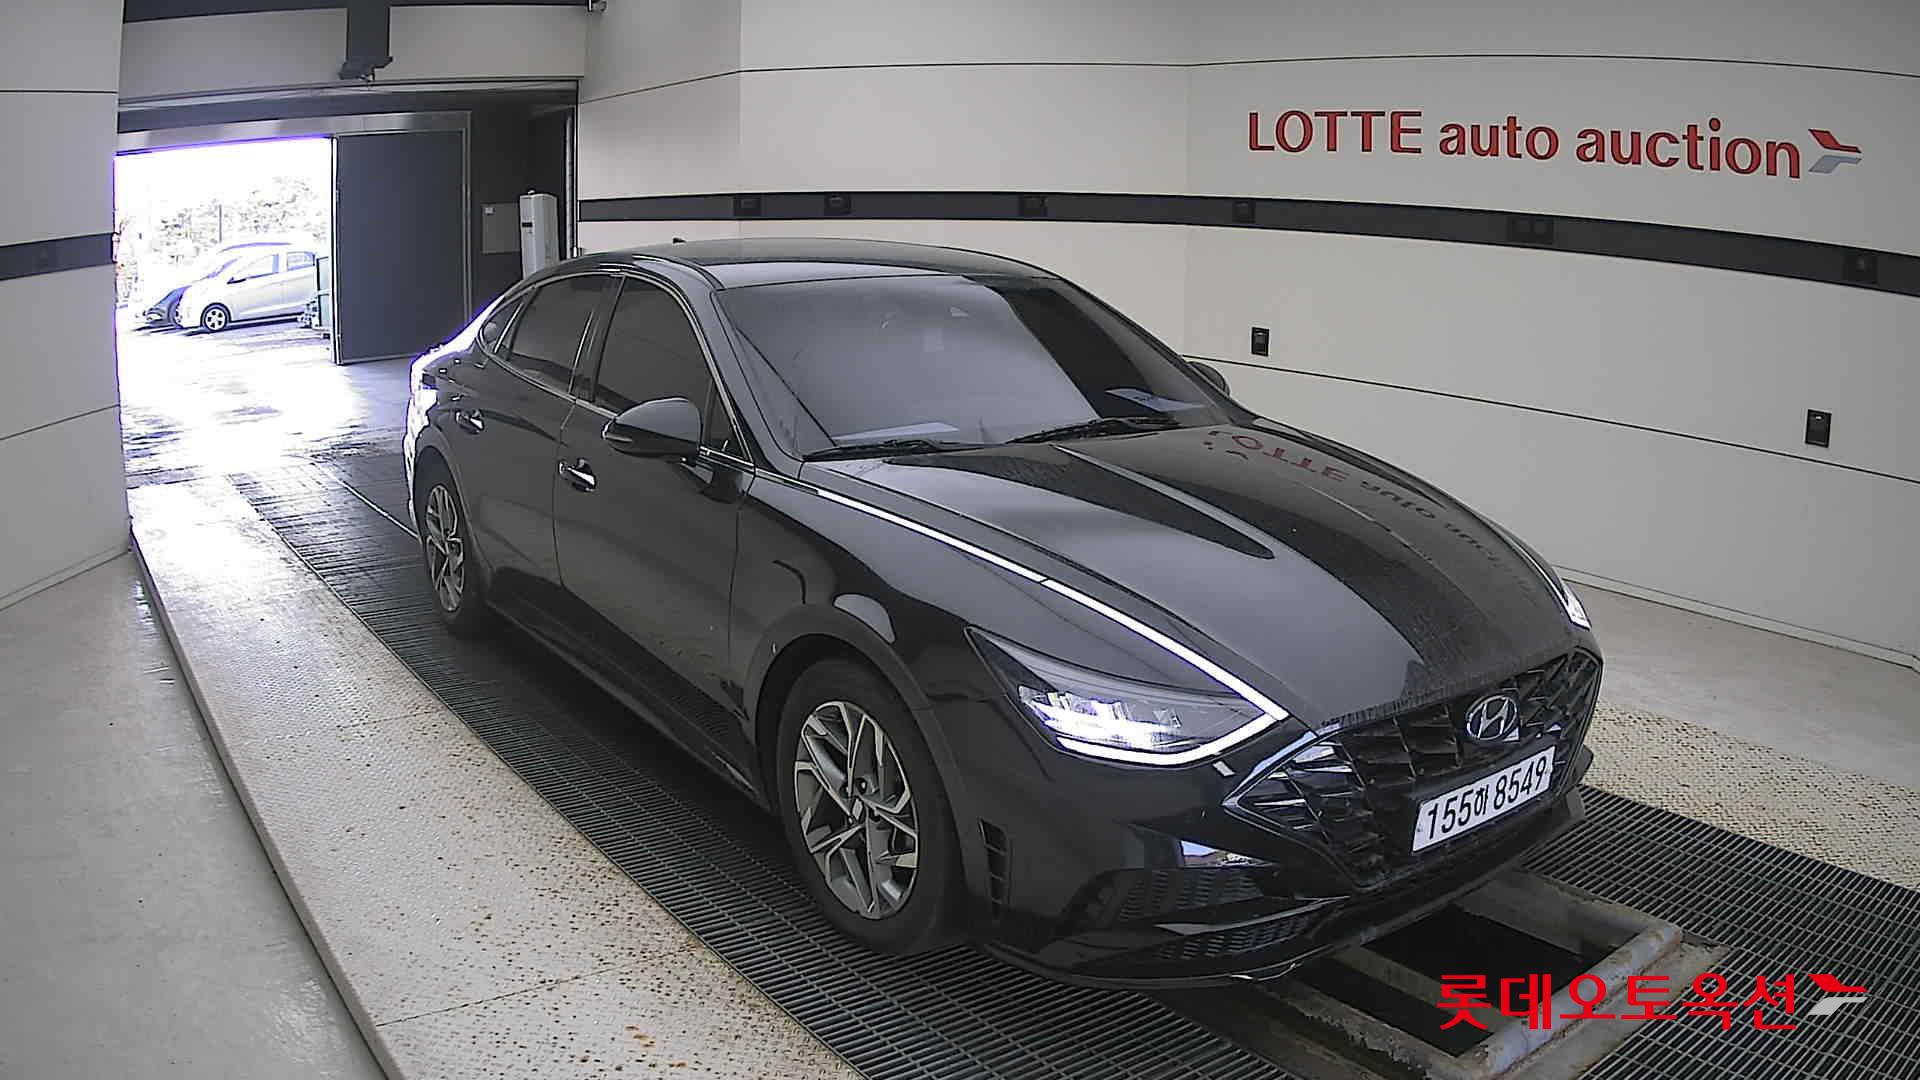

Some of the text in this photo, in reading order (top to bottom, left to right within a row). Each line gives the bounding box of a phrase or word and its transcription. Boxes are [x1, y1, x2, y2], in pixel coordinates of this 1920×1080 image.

[1249, 111, 1801, 179] LOTTE auto auction
[1493, 757, 1547, 810] 8549
